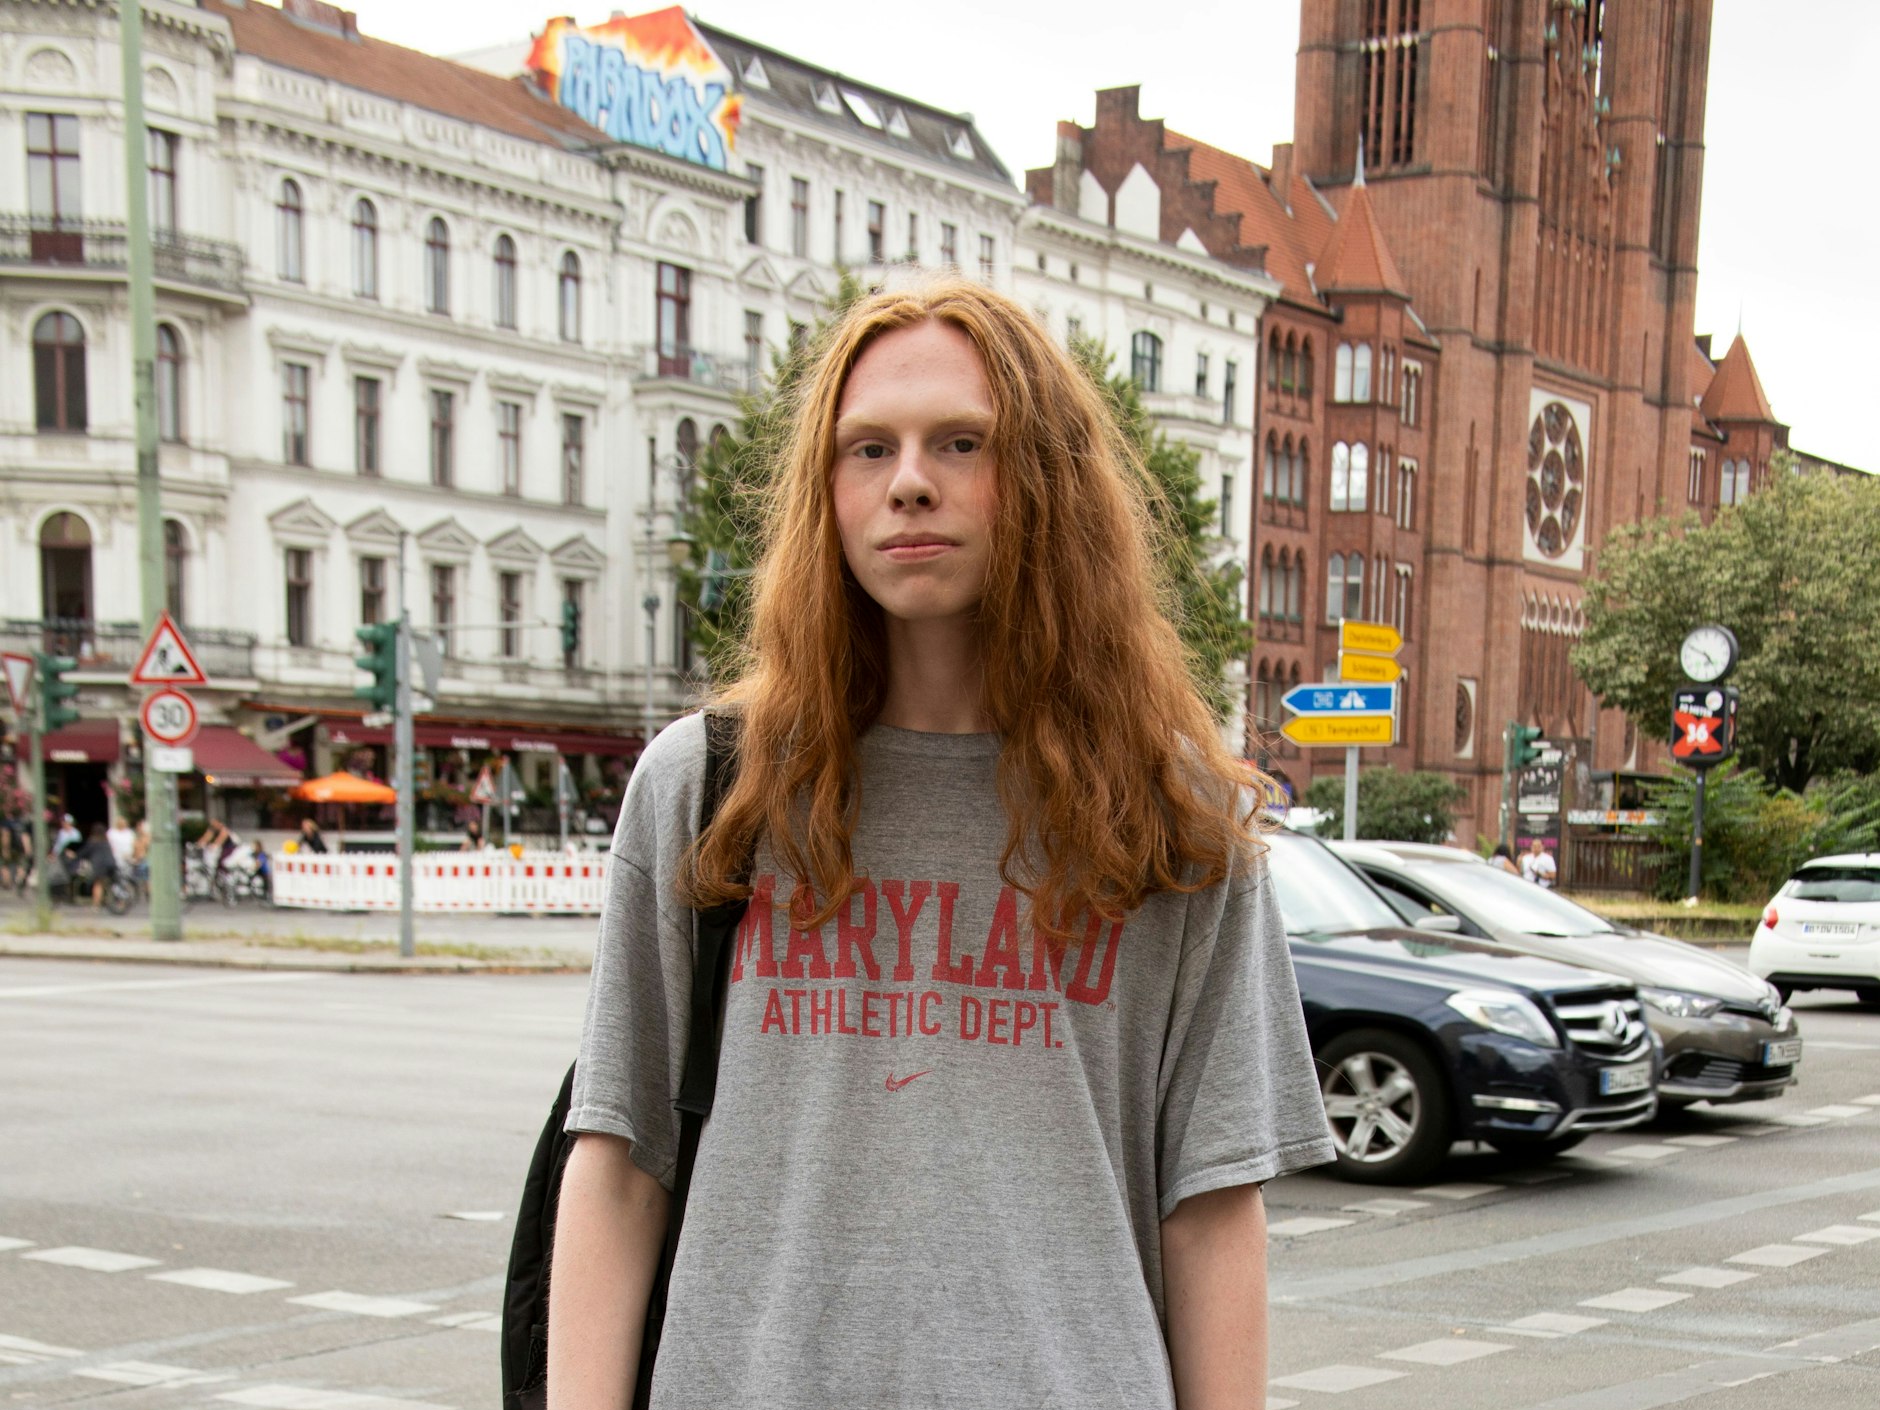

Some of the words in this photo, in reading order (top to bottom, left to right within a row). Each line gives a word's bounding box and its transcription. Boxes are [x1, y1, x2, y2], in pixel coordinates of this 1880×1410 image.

[560, 36, 727, 171] PARADOX
[156, 703, 186, 728] 30
[1327, 723, 1380, 737] Tempelhof
[1687, 723, 1708, 743] 36
[732, 873, 1125, 1006] MARYLAND
[761, 987, 942, 1038] ATHLETIC
[959, 995, 1064, 1049] DEPT.
